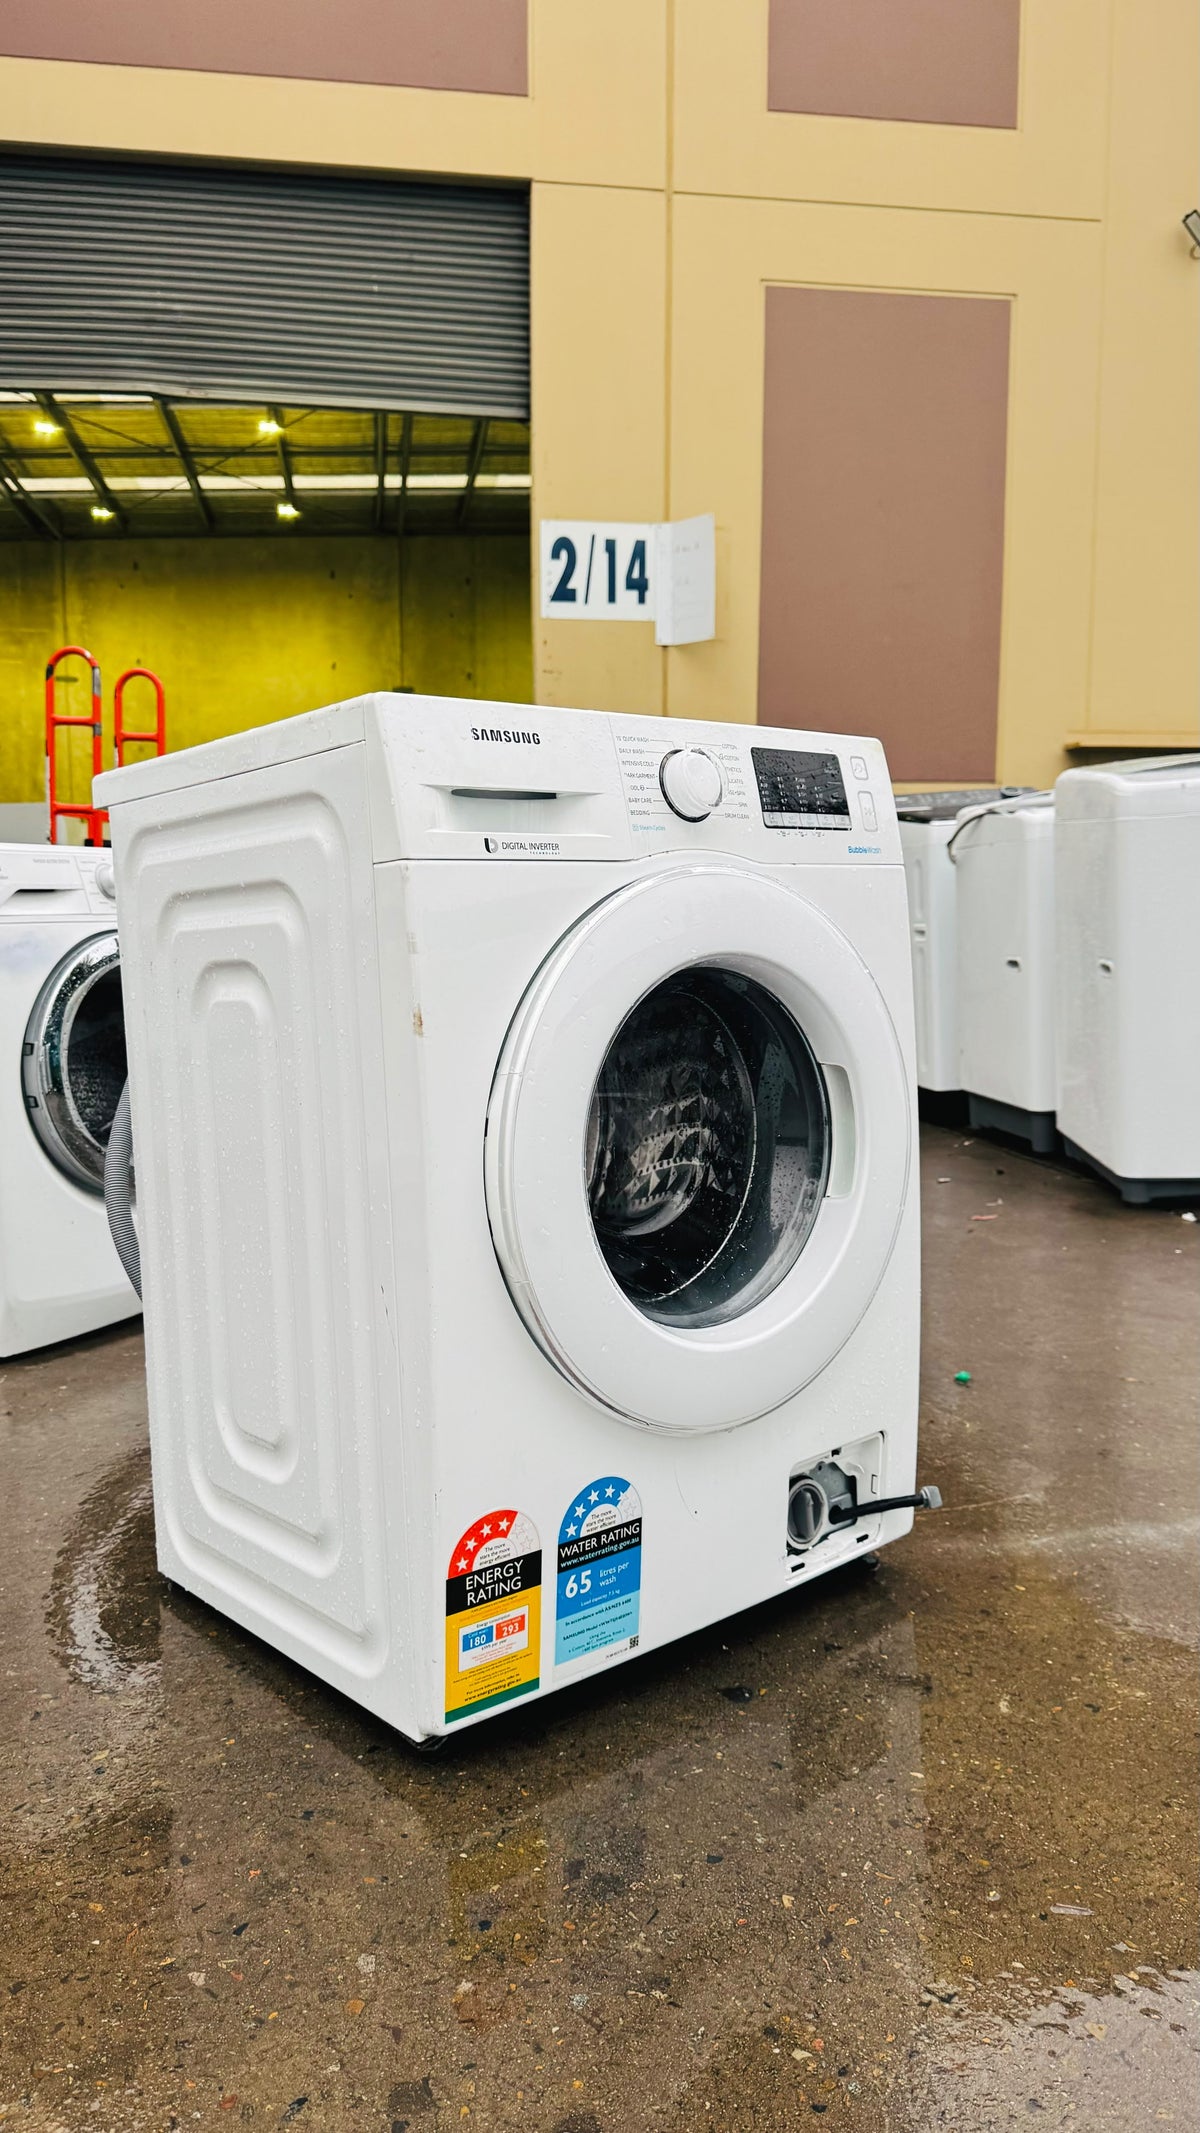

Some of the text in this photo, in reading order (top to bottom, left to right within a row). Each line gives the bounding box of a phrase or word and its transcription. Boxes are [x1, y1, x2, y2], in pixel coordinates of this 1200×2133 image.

[550, 534, 649, 605] 2/14
[471, 728, 541, 745] SAMSUNG
[501, 841, 560, 851] DIGITAL INVERTER
[560, 1522, 640, 1558] WATER RATING
[560, 1537, 640, 1568] www.waterrating.gov.au
[466, 1560, 524, 1591] ENERGY
[565, 1562, 630, 1599] 65 litres per
[599, 1575, 617, 1587] wash
[467, 1576, 522, 1606] RATING
[470, 1634, 487, 1648] 180
[502, 1622, 520, 1637] 293
